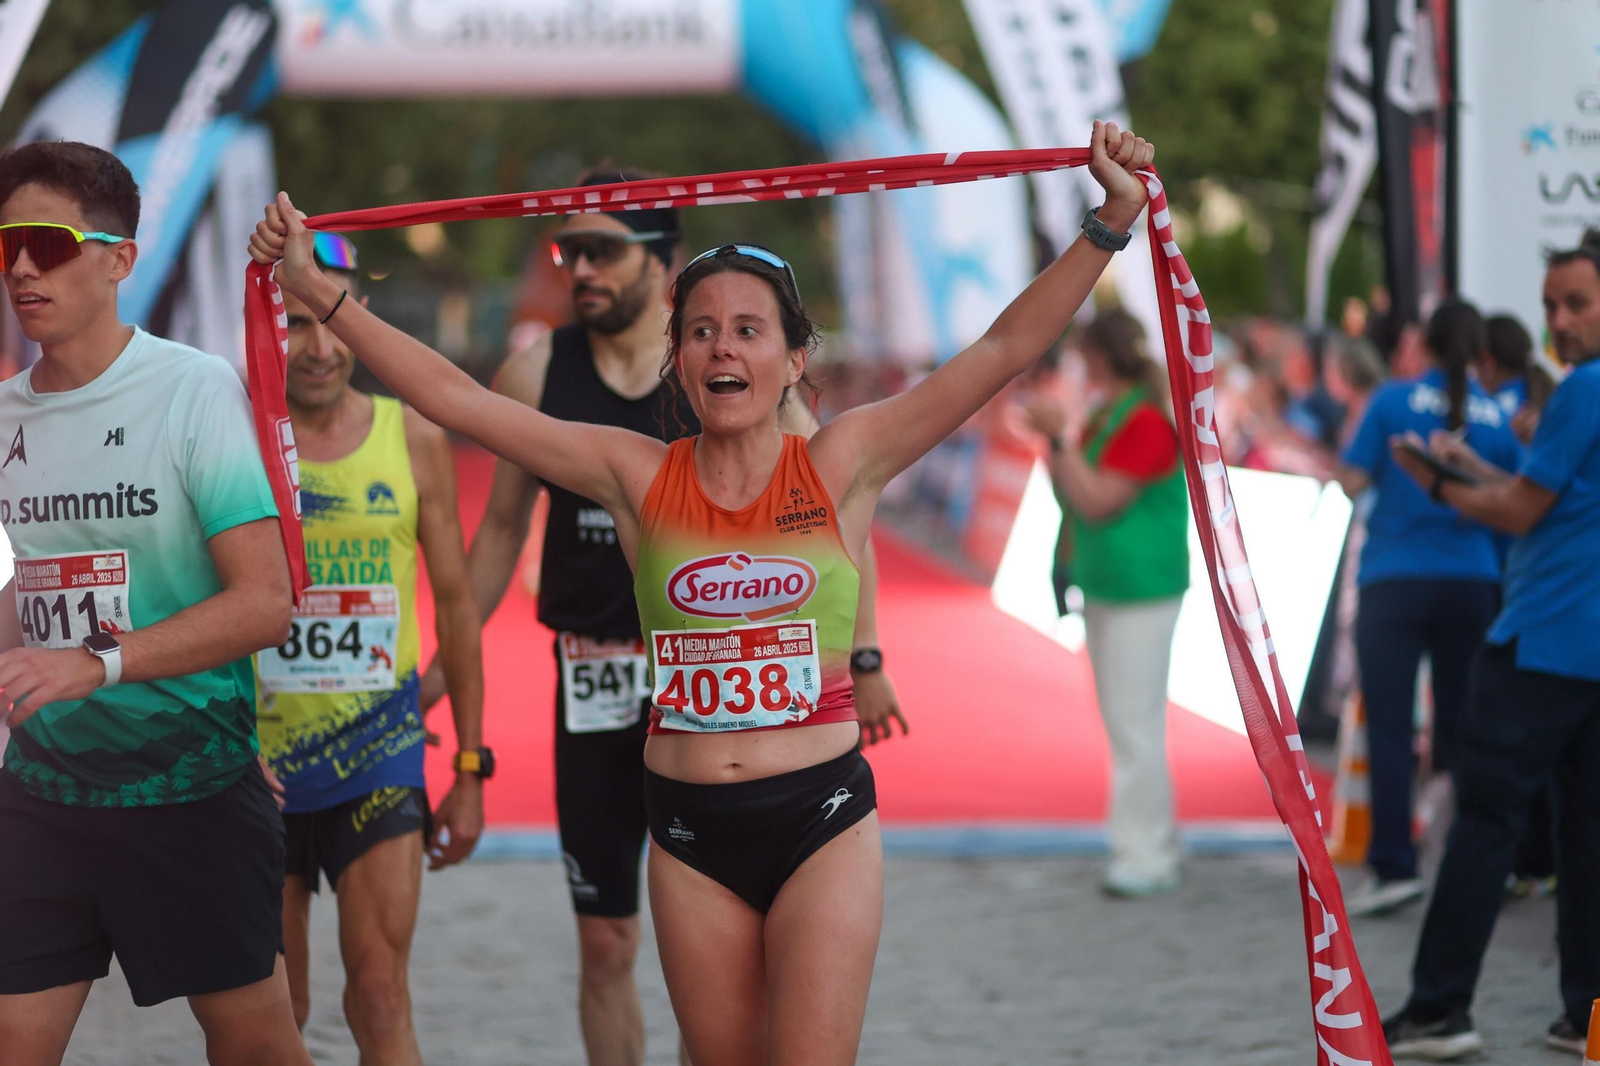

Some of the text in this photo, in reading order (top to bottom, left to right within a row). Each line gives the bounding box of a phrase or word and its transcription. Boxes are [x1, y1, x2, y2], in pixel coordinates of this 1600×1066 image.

[775, 507, 827, 527] SERRANO
[780, 520, 827, 533] CLUB ATLETISMO
[307, 537, 391, 559] ILLAS DE
[71, 574, 78, 585] 26
[79, 573, 96, 584] ABRIL
[97, 572, 112, 583] 2025
[310, 561, 393, 585] BAIDA
[680, 573, 804, 603] Serrano
[21, 591, 101, 643] 4011
[277, 619, 363, 661] 864
[660, 637, 684, 663] 41
[684, 639, 708, 652] MEDIA
[754, 646, 763, 657] 26
[763, 644, 782, 656] ABRIL
[783, 642, 798, 654] 2025
[684, 651, 705, 662] CIUDAD
[713, 648, 742, 660] GRANADA
[804, 667, 813, 690] SENIOR
[657, 663, 793, 717] 4038
[718, 720, 737, 728] GIMENO
[738, 719, 757, 727] MIQUEL
